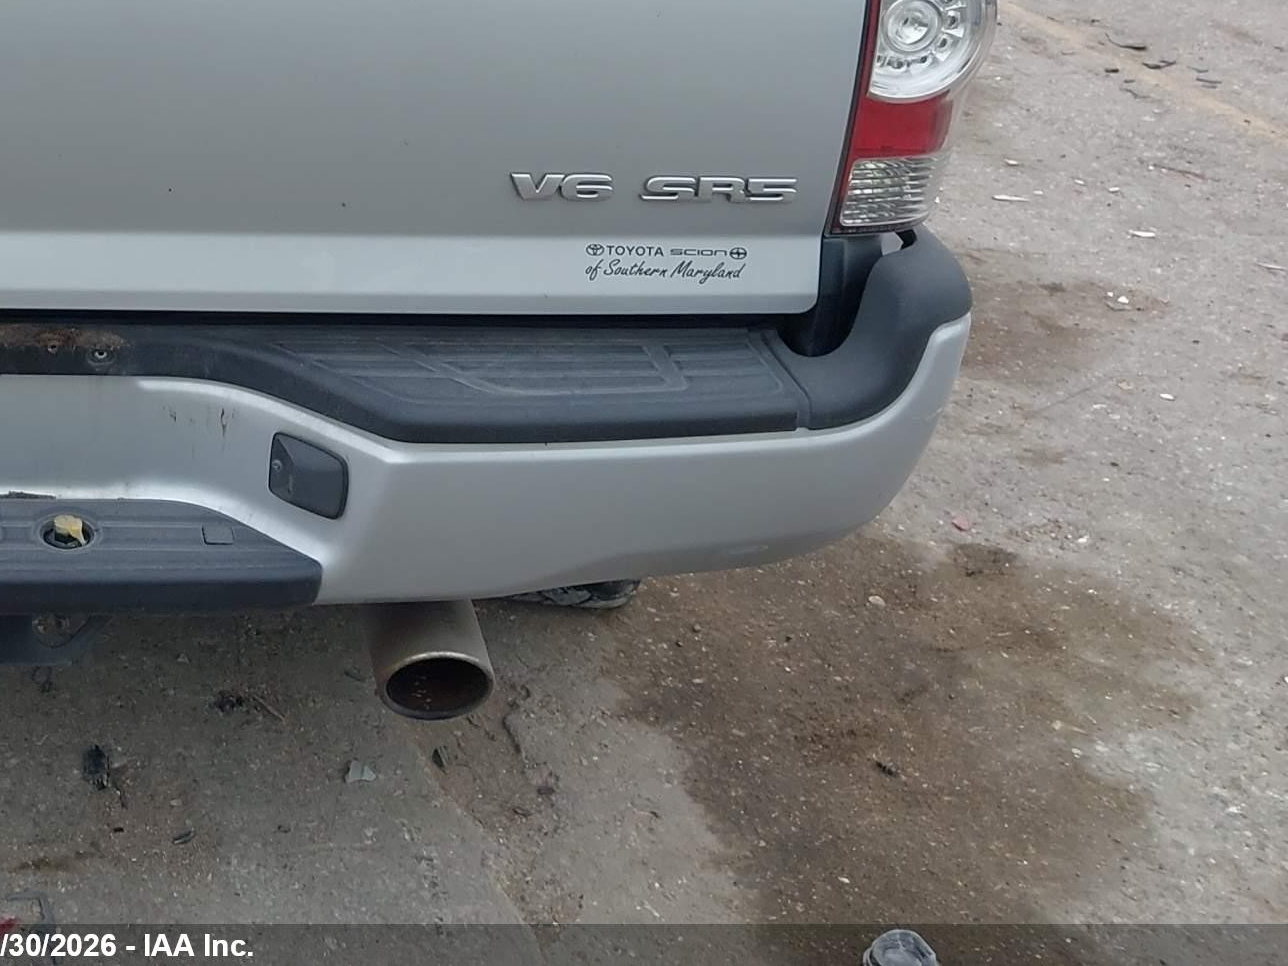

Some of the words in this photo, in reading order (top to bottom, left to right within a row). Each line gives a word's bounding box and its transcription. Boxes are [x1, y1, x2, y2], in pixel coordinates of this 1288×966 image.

[510, 172, 613, 201] V6
[639, 175, 798, 203] SR5
[606, 245, 664, 257] TOYOTA
[585, 254, 604, 281] of
[603, 258, 668, 278] Southern
[670, 260, 746, 284] Maryland
